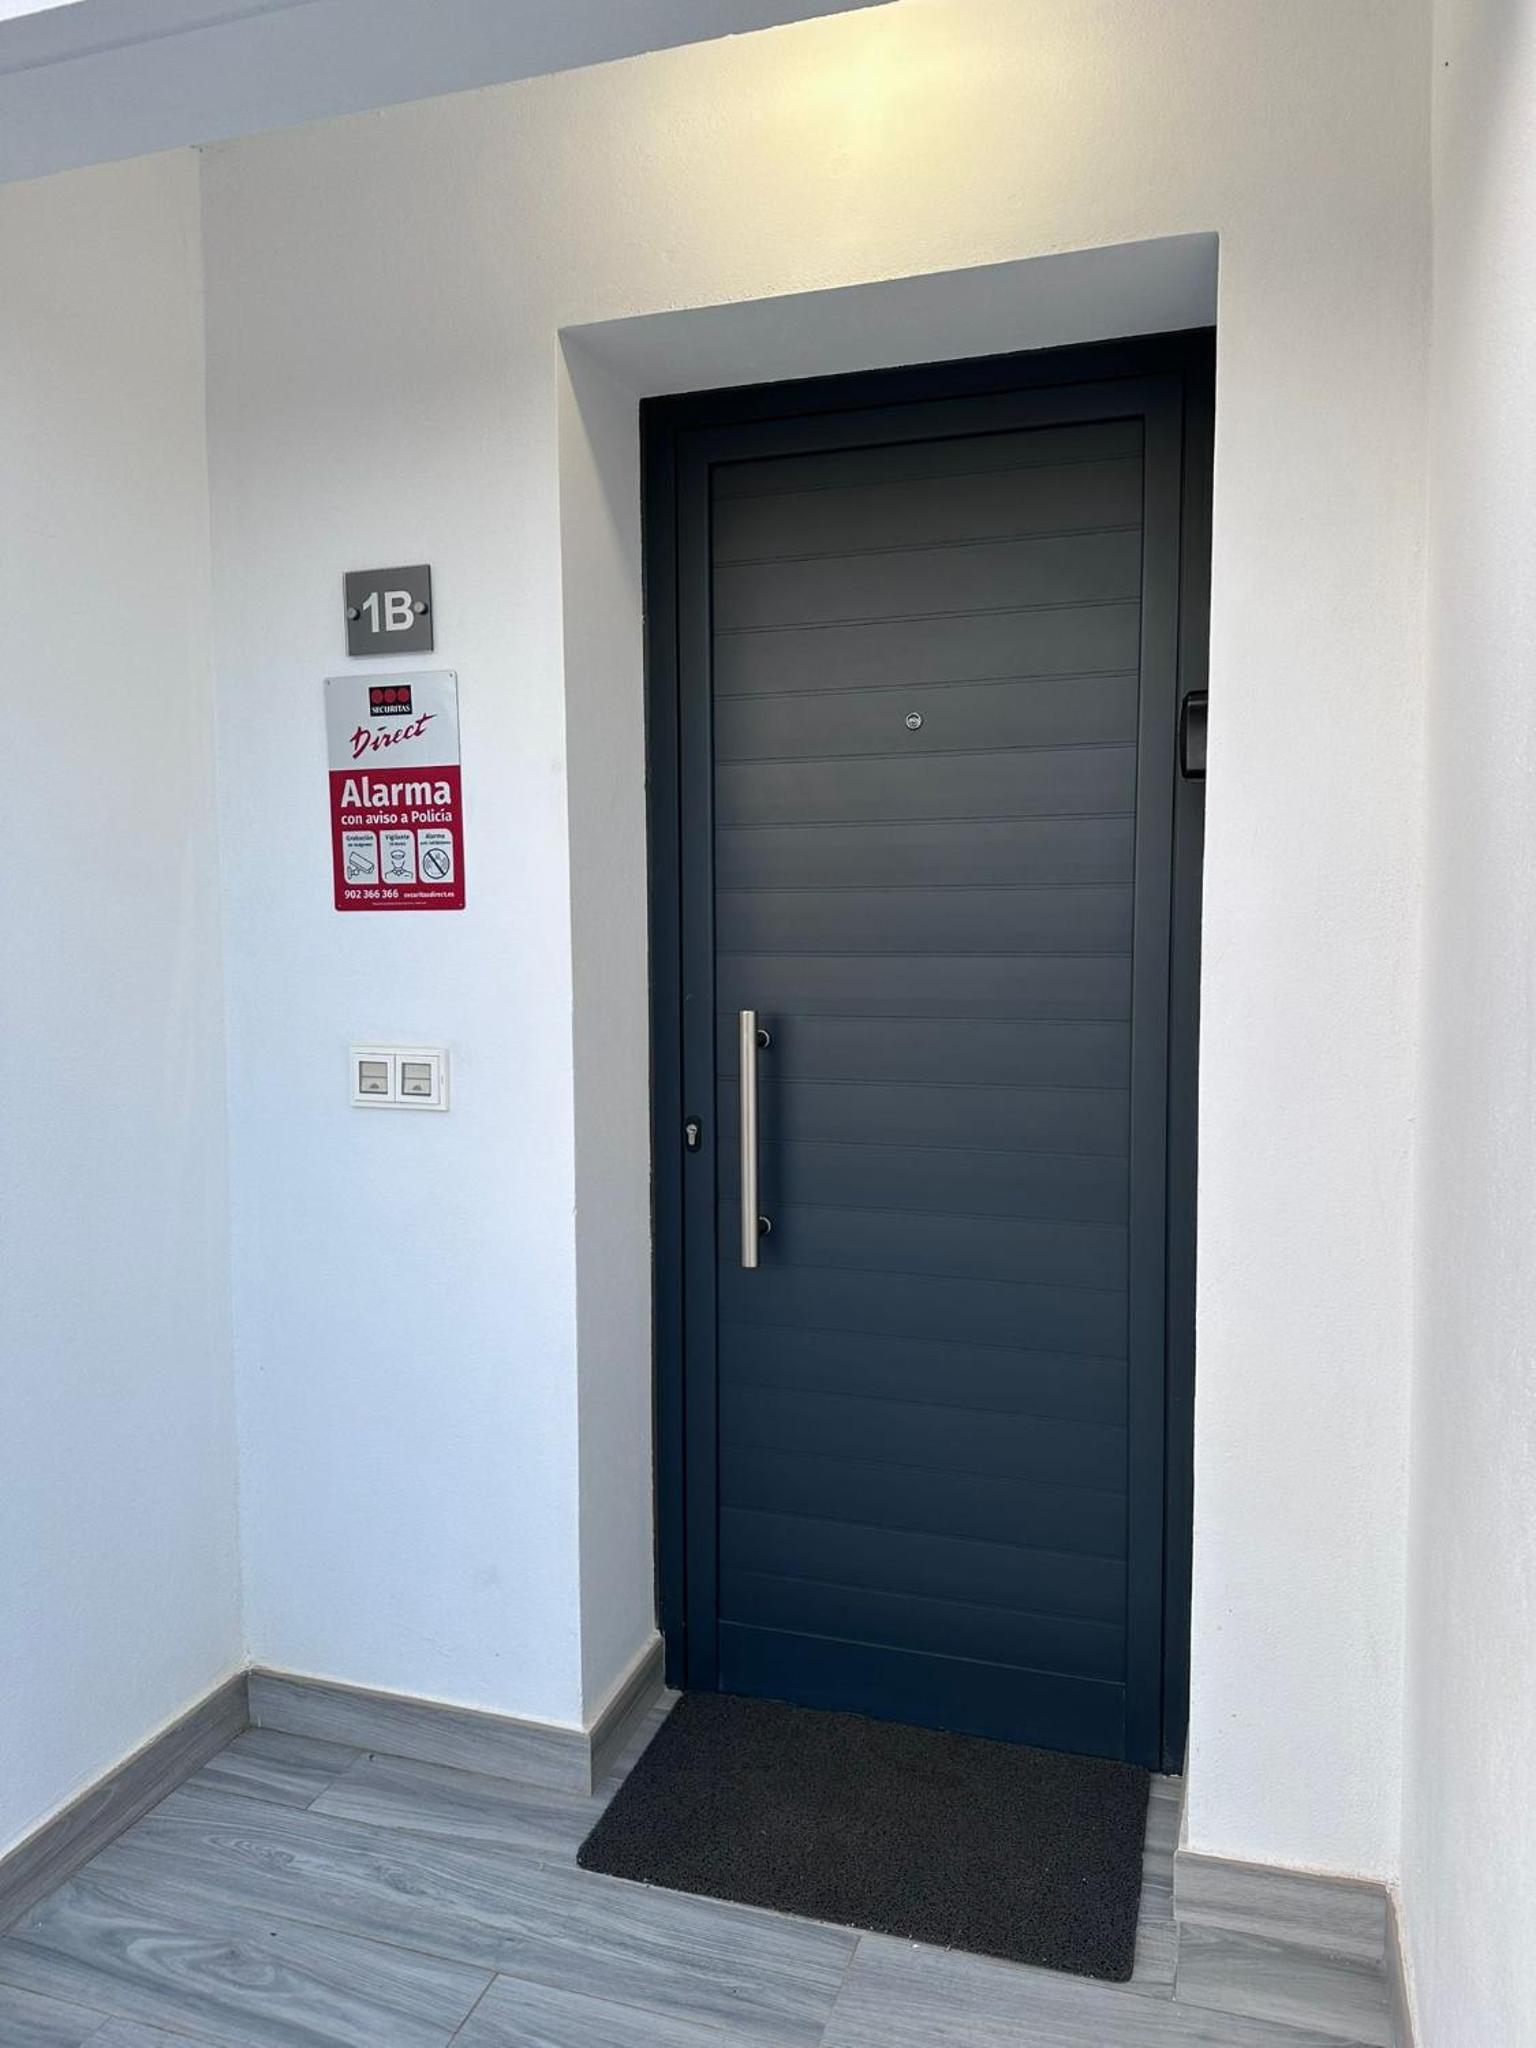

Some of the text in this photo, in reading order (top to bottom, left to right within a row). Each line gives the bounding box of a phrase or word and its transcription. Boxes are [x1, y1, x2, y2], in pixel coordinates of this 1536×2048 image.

[362, 590, 415, 633] 1B
[371, 704, 411, 713] SECURITAS
[349, 712, 438, 759] Direct
[340, 776, 452, 808] Alarma
[340, 808, 453, 825] con aviso a Policía
[344, 888, 400, 899] 902 366 366
